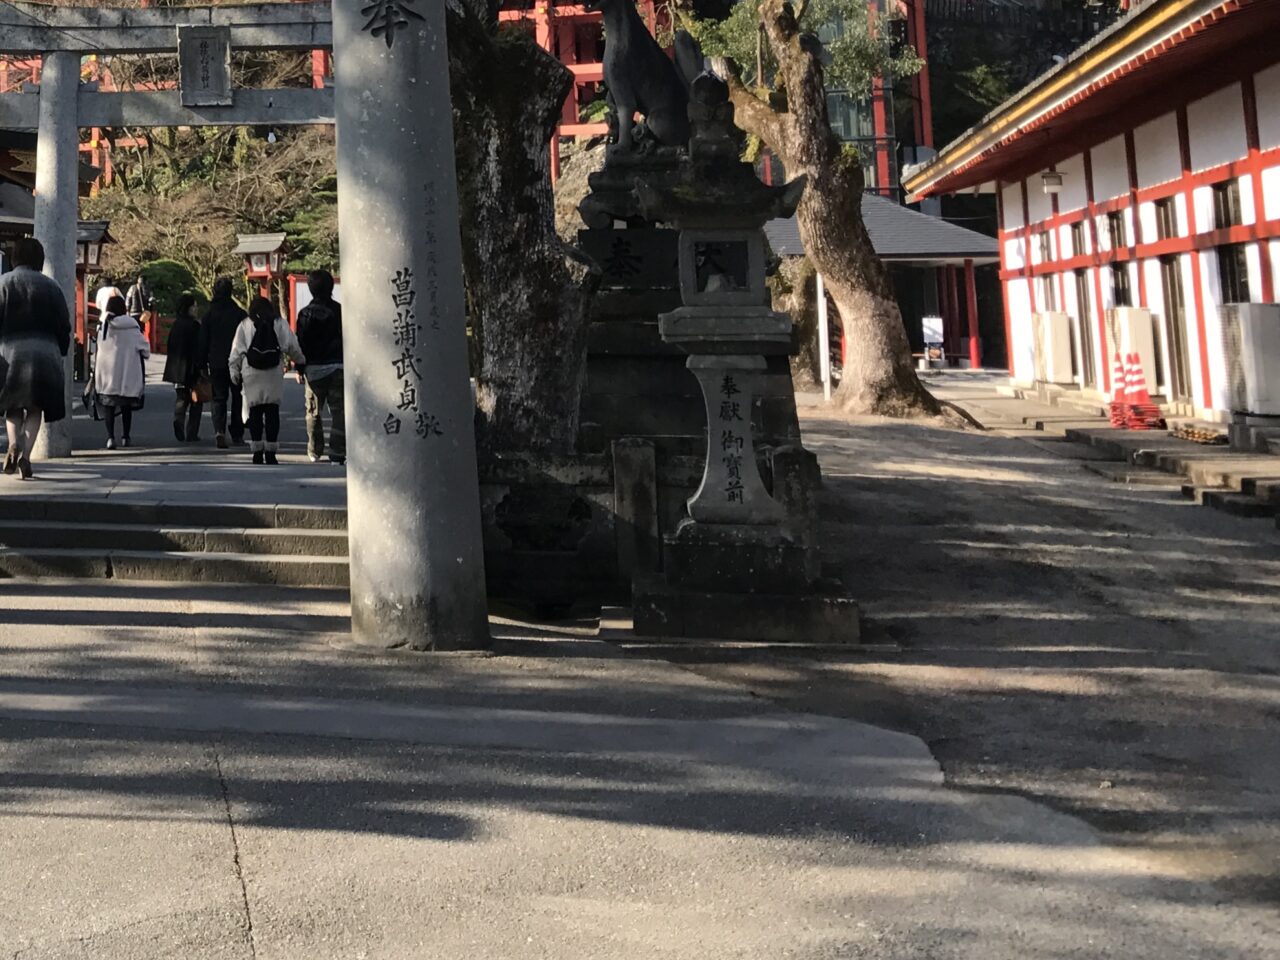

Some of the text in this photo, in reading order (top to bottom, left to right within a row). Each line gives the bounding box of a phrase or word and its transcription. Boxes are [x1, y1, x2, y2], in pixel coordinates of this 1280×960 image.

[603, 236, 643, 279] 奉
[391, 267, 422, 412] 菖蒲武貞
